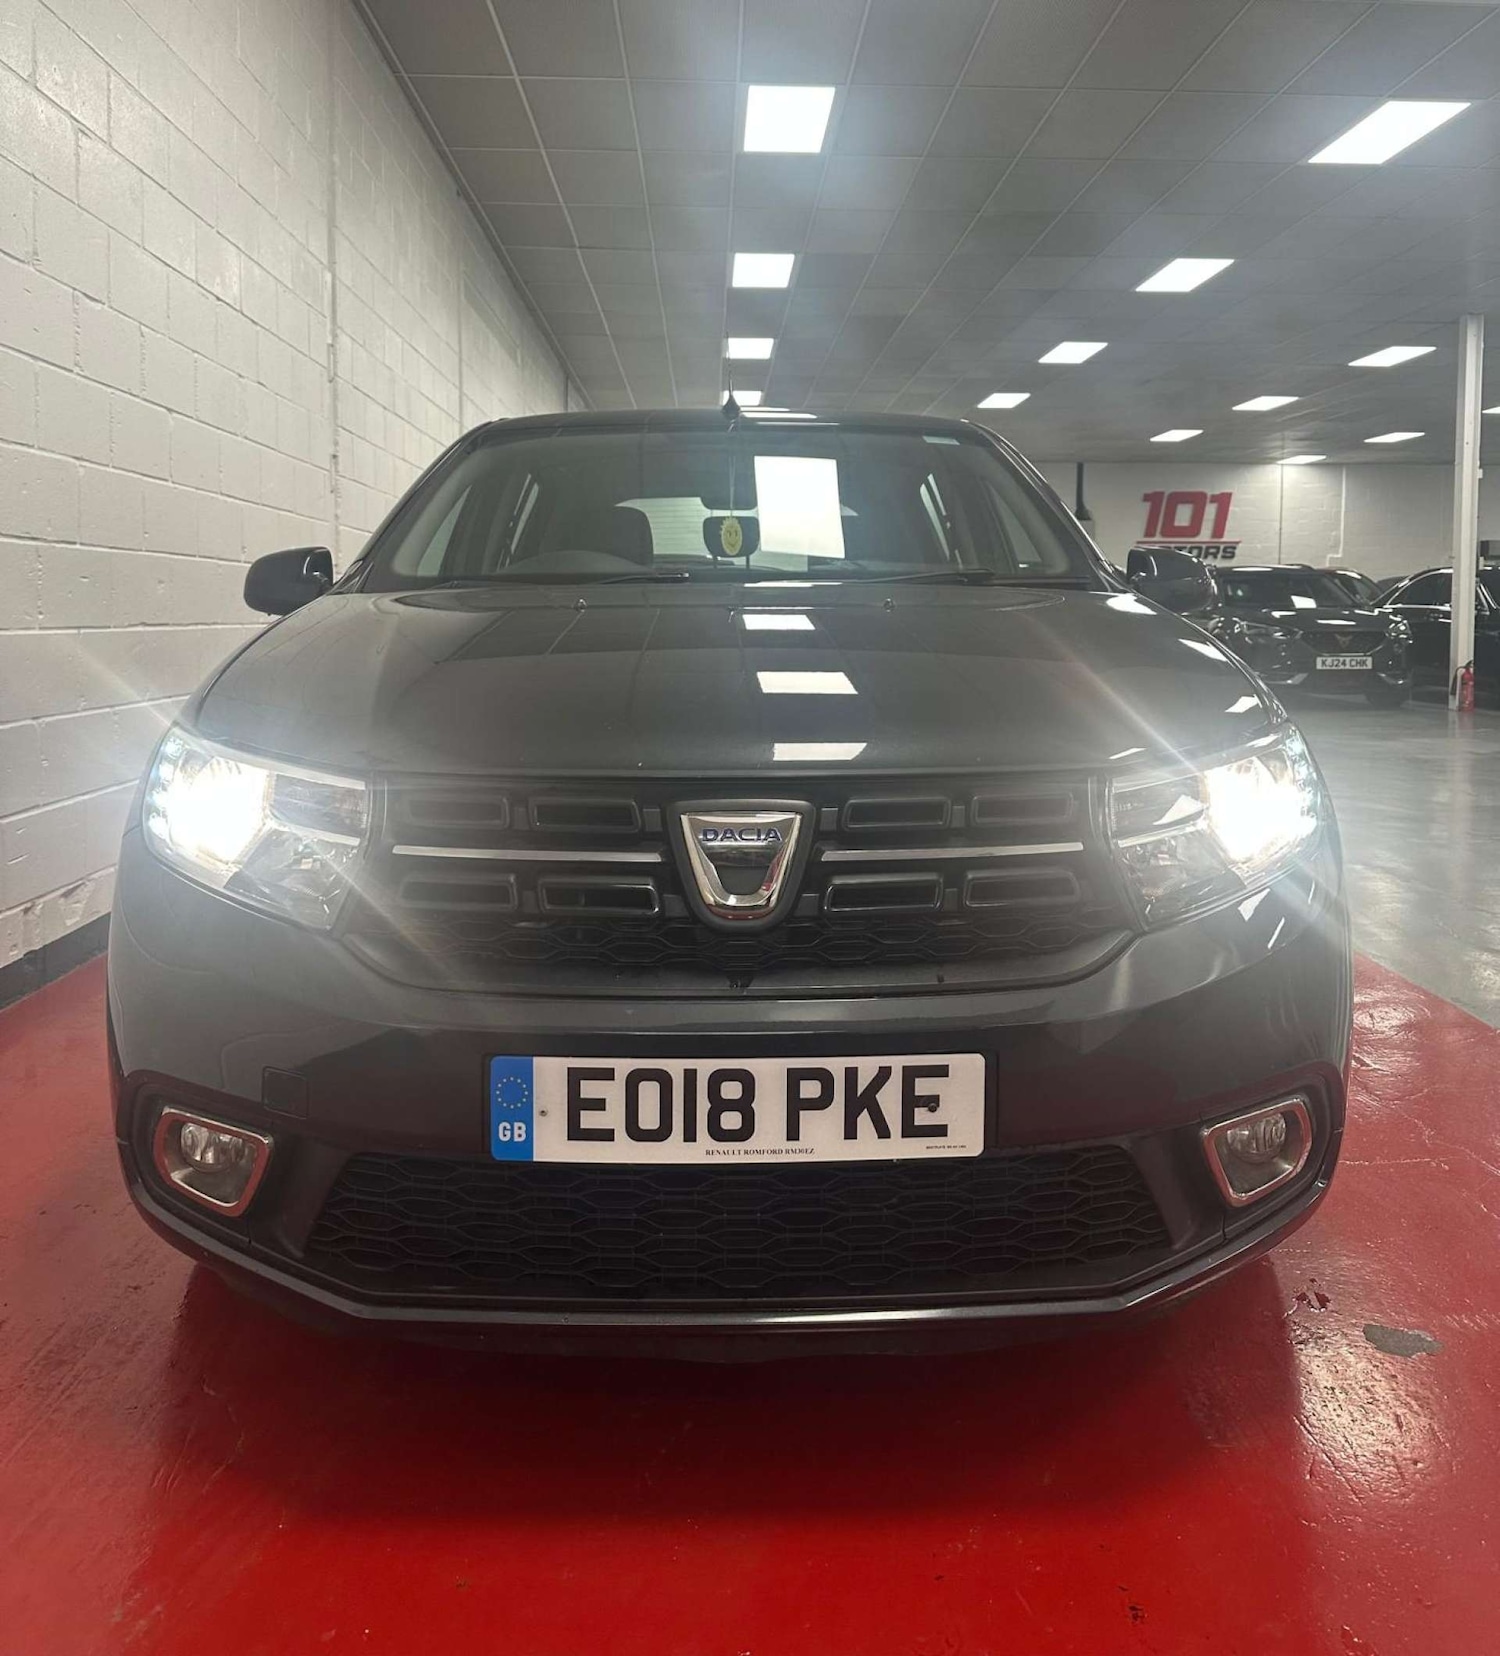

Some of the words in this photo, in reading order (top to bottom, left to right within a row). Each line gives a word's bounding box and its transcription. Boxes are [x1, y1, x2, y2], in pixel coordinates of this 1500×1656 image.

[1142, 491, 1233, 540] 101
[1320, 658, 1347, 669] KJ24
[1349, 658, 1369, 669] CHK
[701, 827, 783, 843] DACIA
[566, 1067, 756, 1143] EO18
[786, 1064, 950, 1142] PKE
[498, 1121, 527, 1142] GB
[705, 1148, 742, 1156] RENAULT
[743, 1147, 784, 1156] ROMFORD
